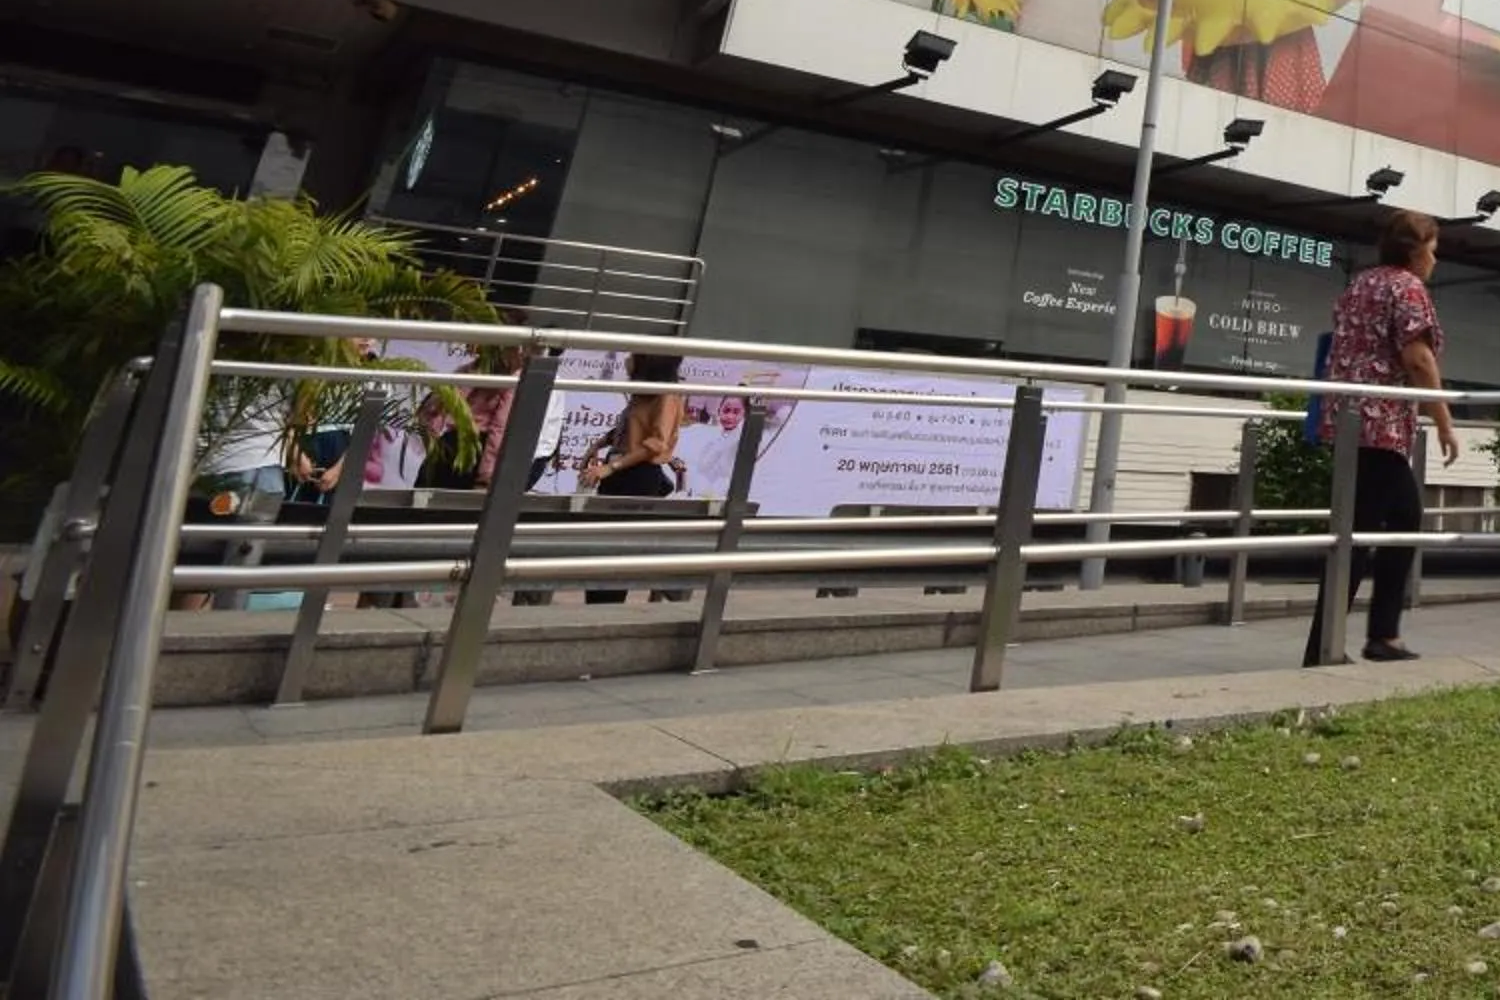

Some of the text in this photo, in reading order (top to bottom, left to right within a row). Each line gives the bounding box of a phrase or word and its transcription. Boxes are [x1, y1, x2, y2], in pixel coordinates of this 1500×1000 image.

[1221, 223, 1333, 268] COFFEE
[1069, 281, 1097, 296] New
[1023, 291, 1117, 315] Coffee Experie
[1242, 299, 1281, 313] NITRO
[1208, 313, 1303, 338] COLD BREW
[837, 459, 855, 472] 20
[859, 460, 925, 476] พฤษภาคม
[928, 463, 960, 476] 2561
